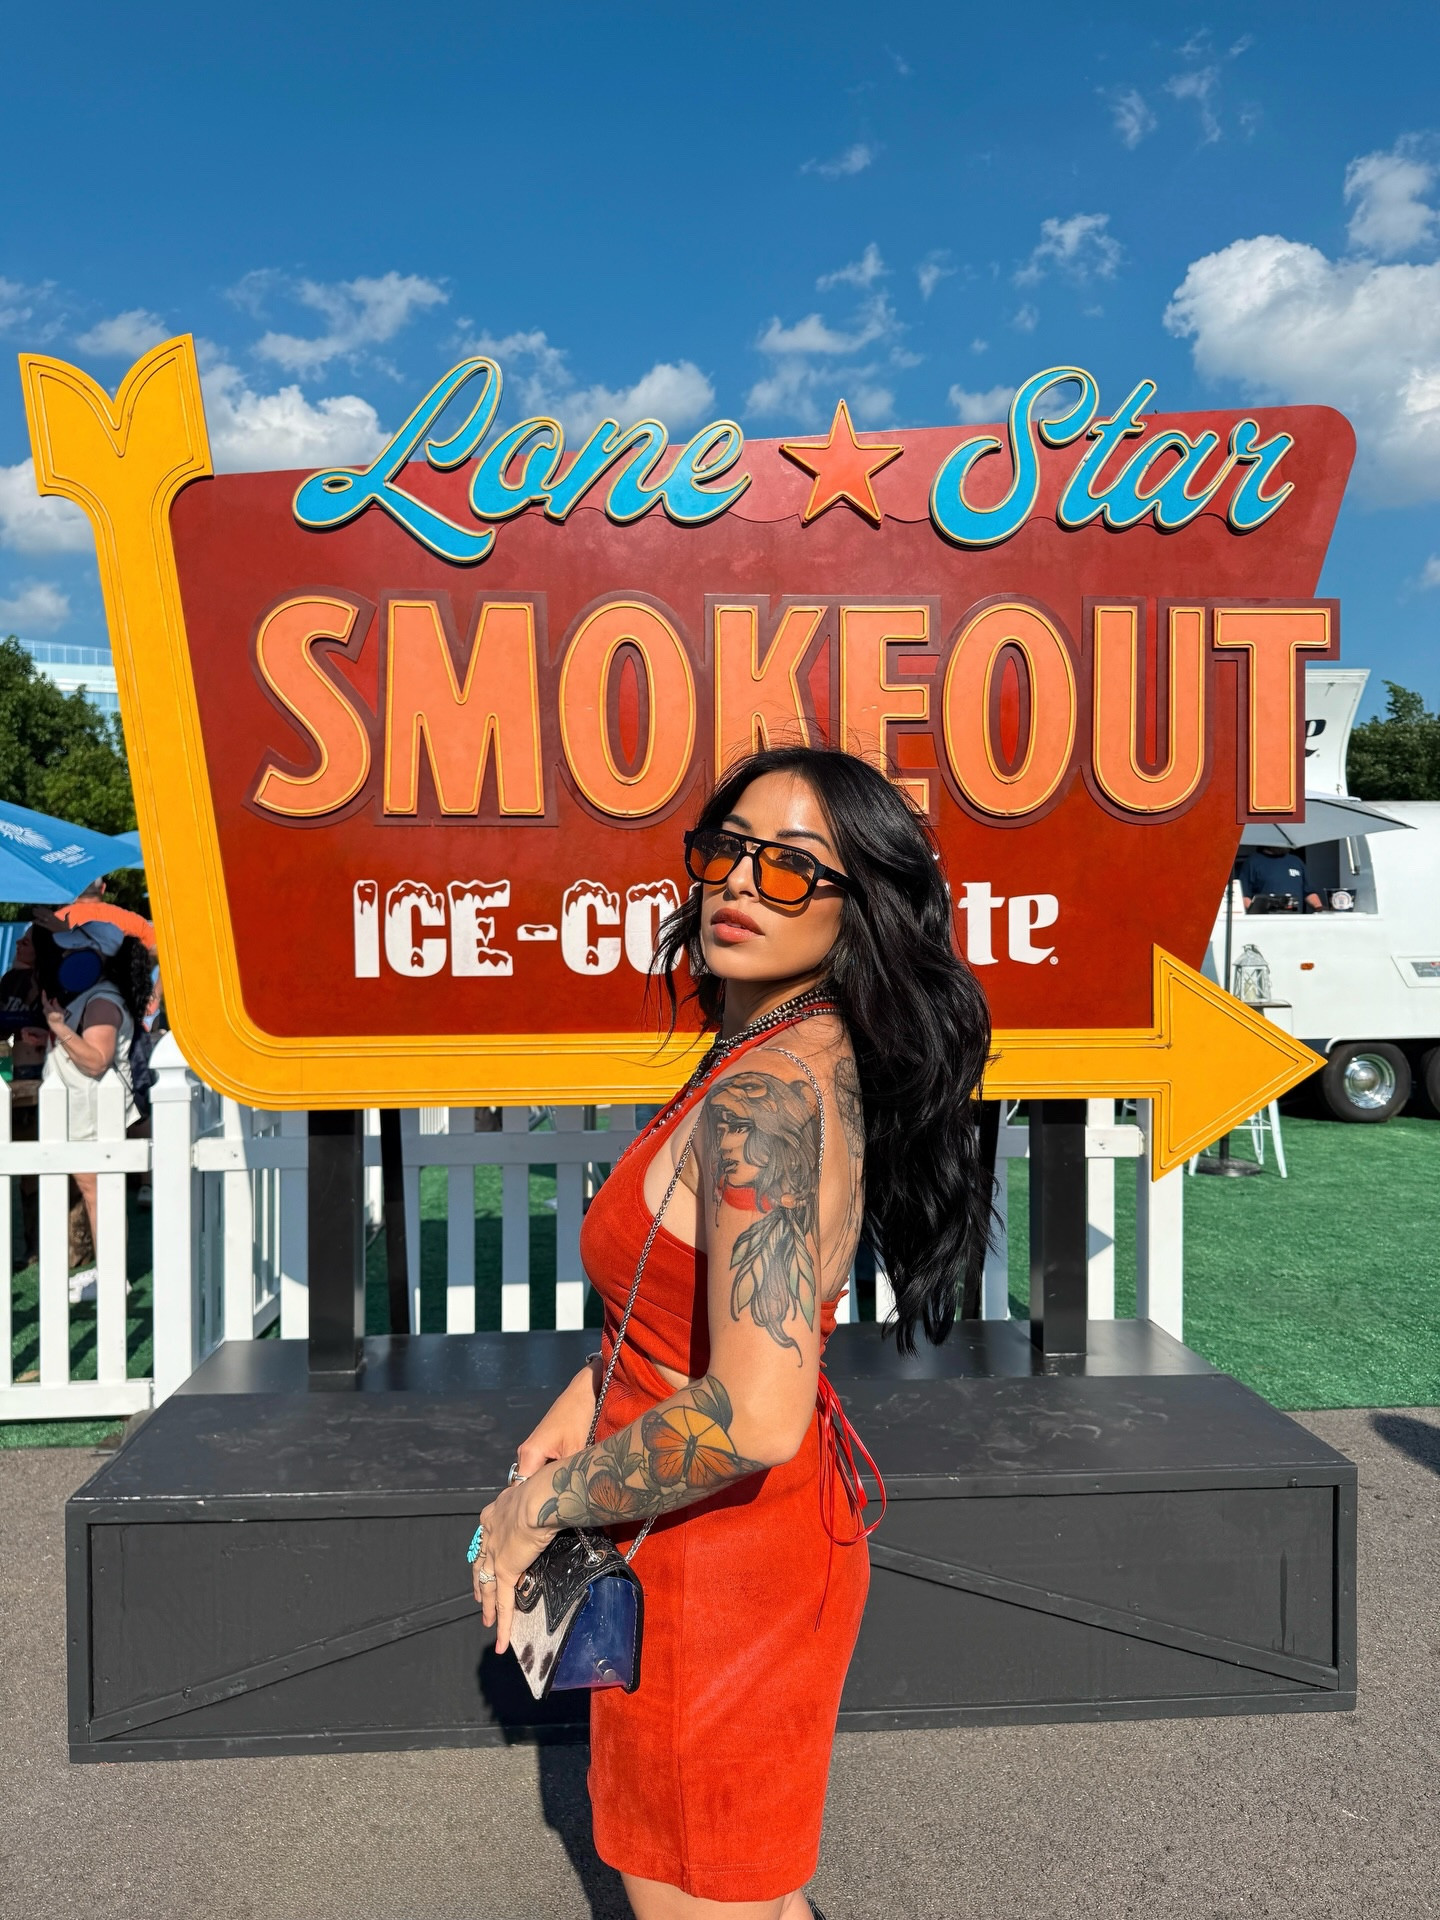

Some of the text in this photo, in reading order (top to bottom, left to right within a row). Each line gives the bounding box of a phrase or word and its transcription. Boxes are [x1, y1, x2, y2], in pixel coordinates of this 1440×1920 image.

[292, 355, 1295, 563] Lone Star
[254, 595, 1332, 817] SMOKEOUT
[353, 879, 704, 979] ICE-CO
